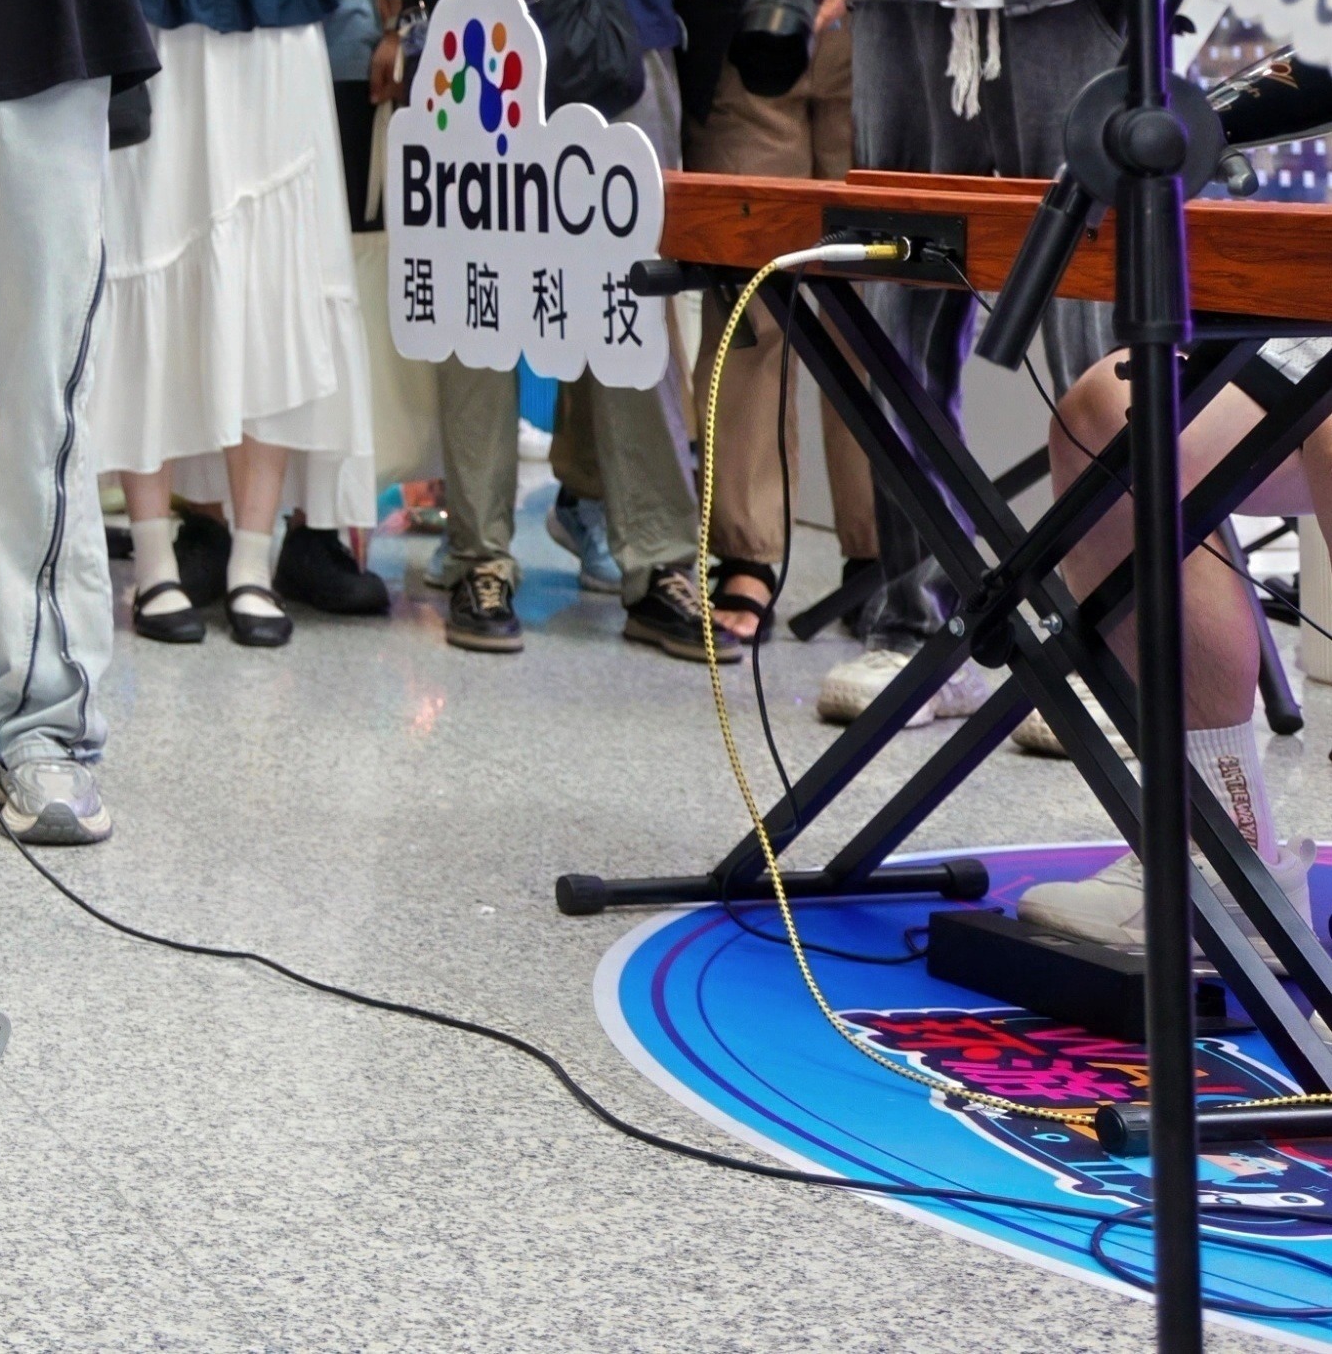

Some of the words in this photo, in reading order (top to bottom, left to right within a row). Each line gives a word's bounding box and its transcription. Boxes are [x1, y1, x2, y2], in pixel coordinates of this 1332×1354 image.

[402, 134, 639, 238] BrainCo
[404, 257, 643, 348] 强脑科技
